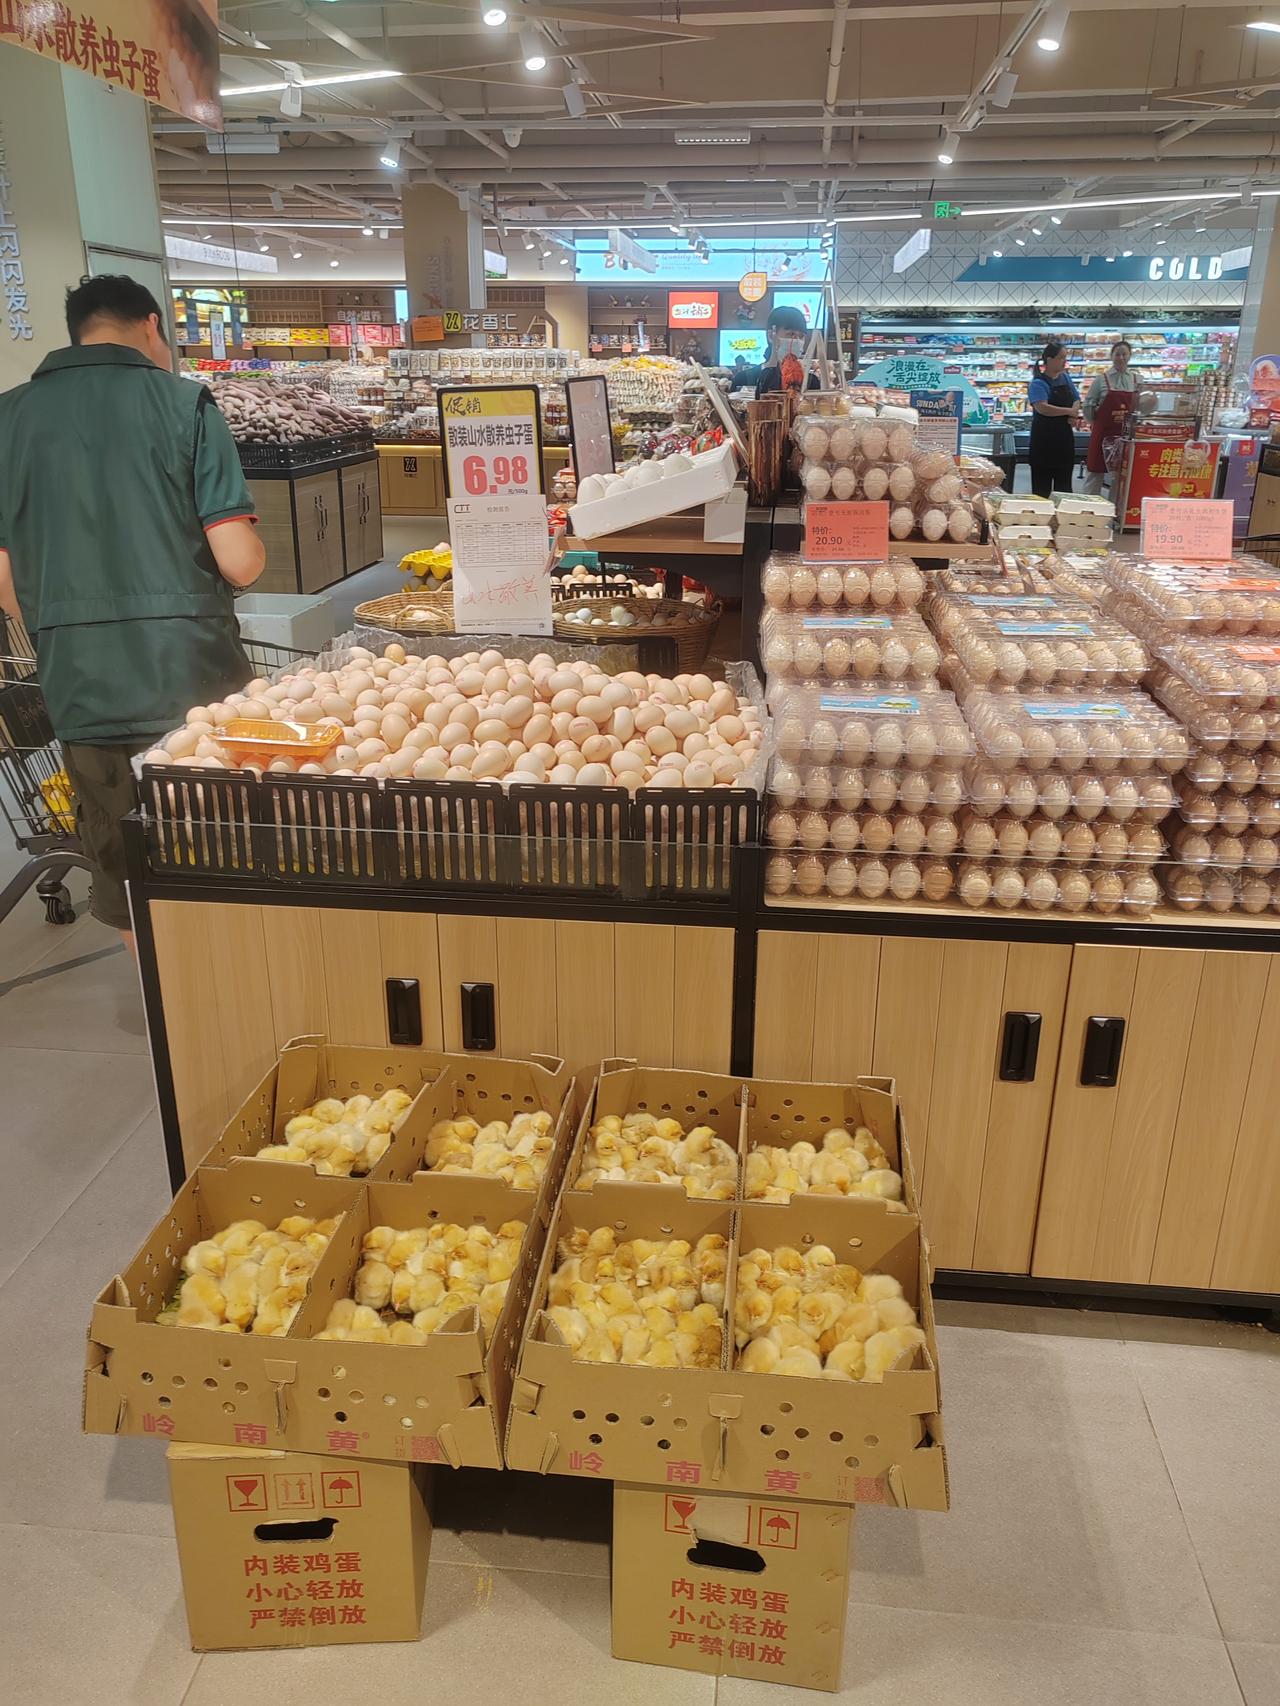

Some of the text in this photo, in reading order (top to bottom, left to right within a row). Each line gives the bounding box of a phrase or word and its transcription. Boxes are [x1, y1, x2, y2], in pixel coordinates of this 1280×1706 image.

[1148, 256, 1223, 281] COLD
[463, 314, 517, 330] 花香汇
[886, 359, 930, 374] 浪漫在
[446, 397, 482, 416] 促销
[448, 424, 533, 447] 散装山水散养虫子蛋
[463, 455, 528, 495] 6.98
[816, 537, 843, 545] 20.90
[1154, 534, 1183, 544] 19.90
[244, 1552, 361, 1577] 内装鸡蛋
[246, 1579, 365, 1602] 小心轻放
[671, 1578, 789, 1614] 内装鸡蛋
[249, 1605, 367, 1629] 严禁倒放
[669, 1605, 788, 1640] 小心轻放
[668, 1630, 787, 1665] 严禁倒放
